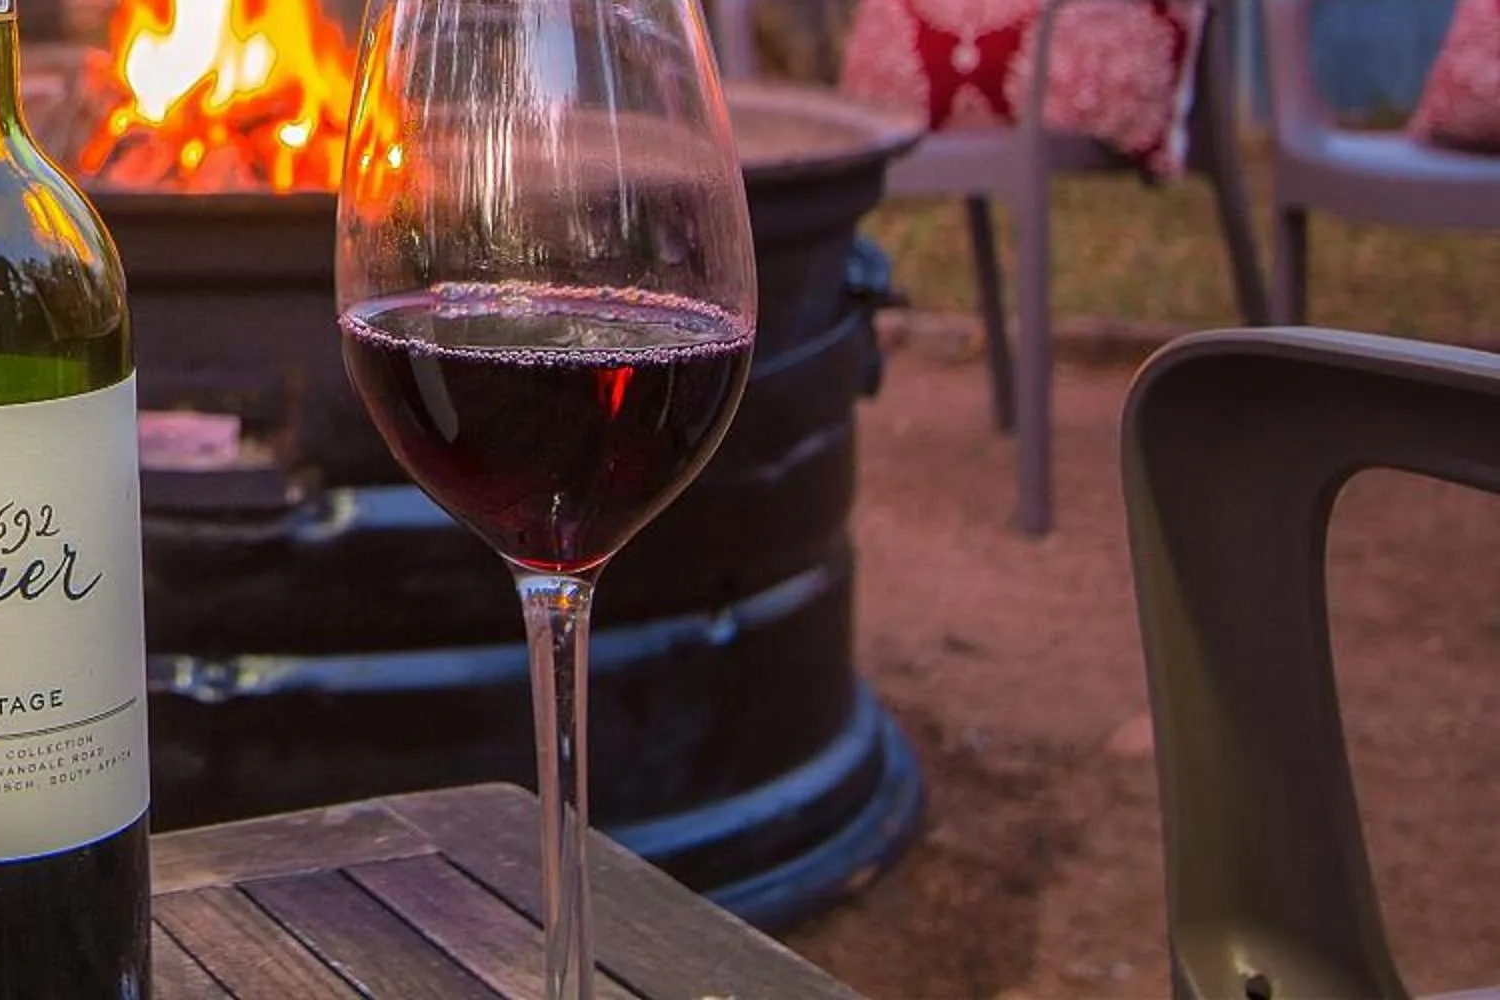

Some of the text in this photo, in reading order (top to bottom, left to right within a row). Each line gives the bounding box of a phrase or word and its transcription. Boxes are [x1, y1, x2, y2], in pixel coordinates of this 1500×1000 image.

[4, 734, 94, 760] COLLECTION
[71, 746, 105, 764] ROAD
[50, 767, 92, 785] SOUTH
[98, 749, 132, 772] AFRICA
